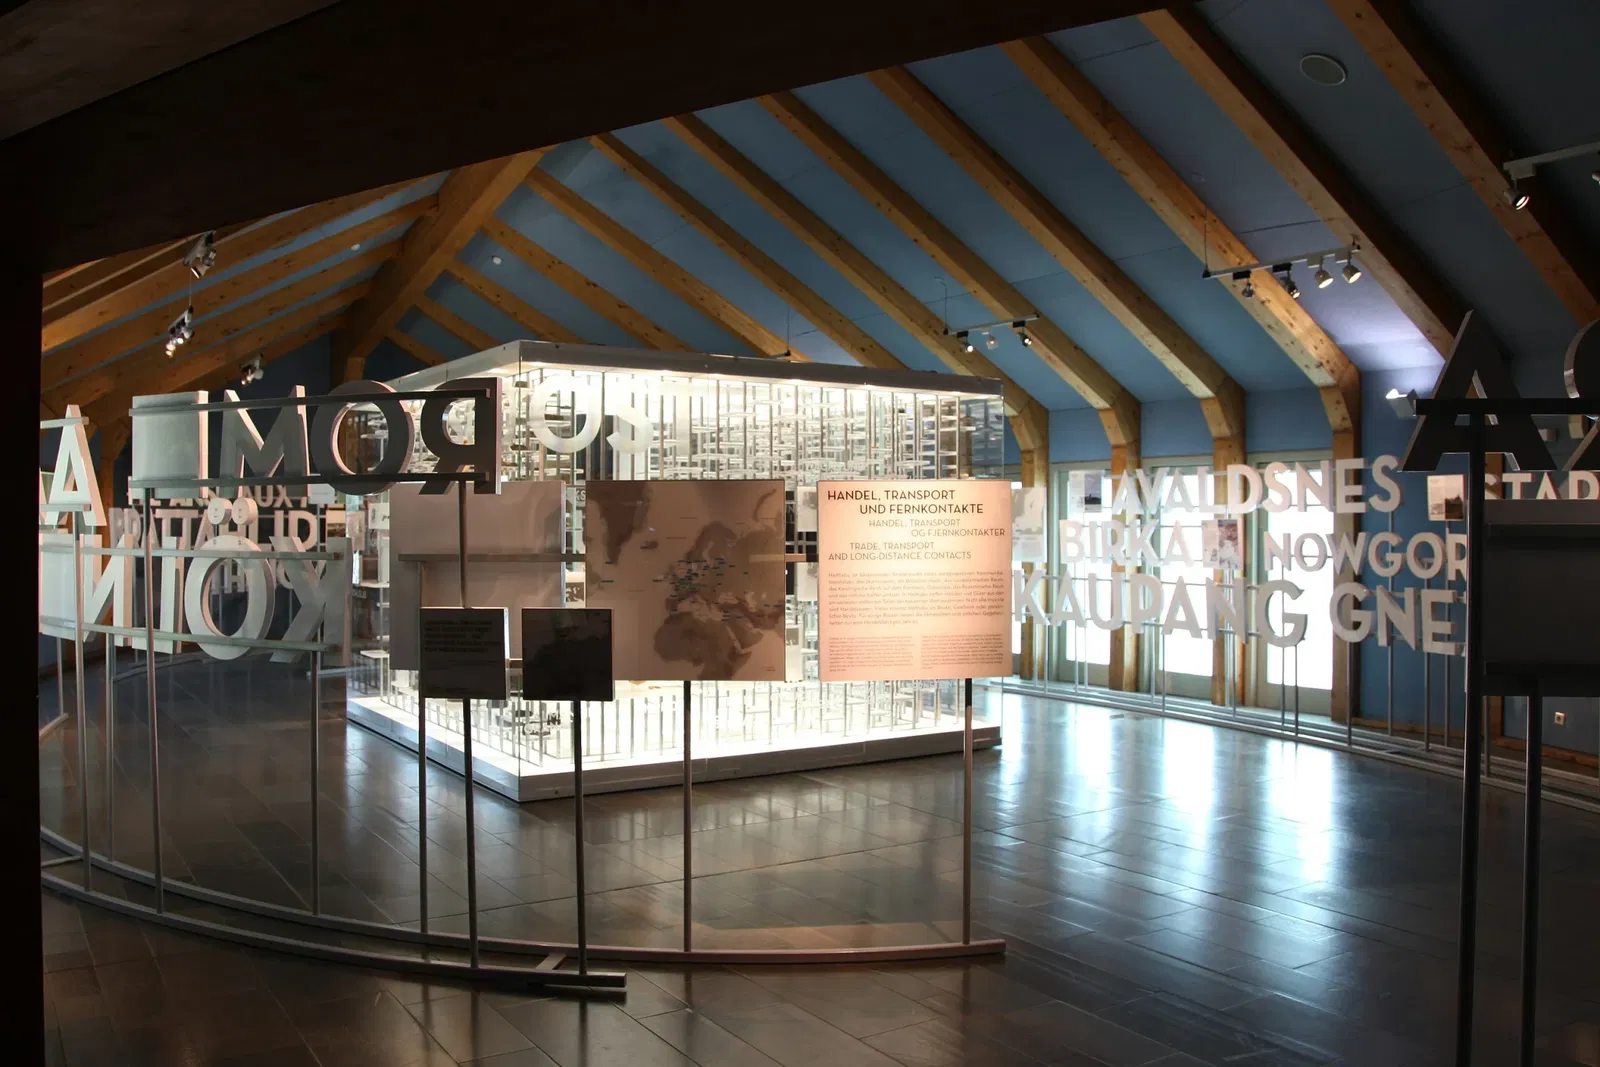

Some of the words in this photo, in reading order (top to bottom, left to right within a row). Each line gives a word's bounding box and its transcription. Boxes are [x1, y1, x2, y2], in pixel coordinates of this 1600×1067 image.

[1112, 455, 1402, 515] AVALDSNES
[827, 490, 881, 501] HANDEL,
[884, 489, 956, 500] TRANSPORT
[860, 504, 886, 515] UND
[889, 503, 984, 514] FERNKONTAKTE
[909, 518, 960, 527] TRANSPORT
[911, 528, 926, 537] OG
[927, 528, 1005, 537] FJERNKONTAKTER
[850, 542, 881, 551] TRADE,
[884, 541, 935, 550] TRANSPORT
[1059, 517, 1195, 567] BIRKA
[828, 552, 848, 561] AND
[850, 551, 923, 561] LONG-DISTANCE
[924, 551, 972, 560] CONTACTS
[1013, 568, 1308, 648] KAUPANG
[1329, 582, 1467, 657] GNE
